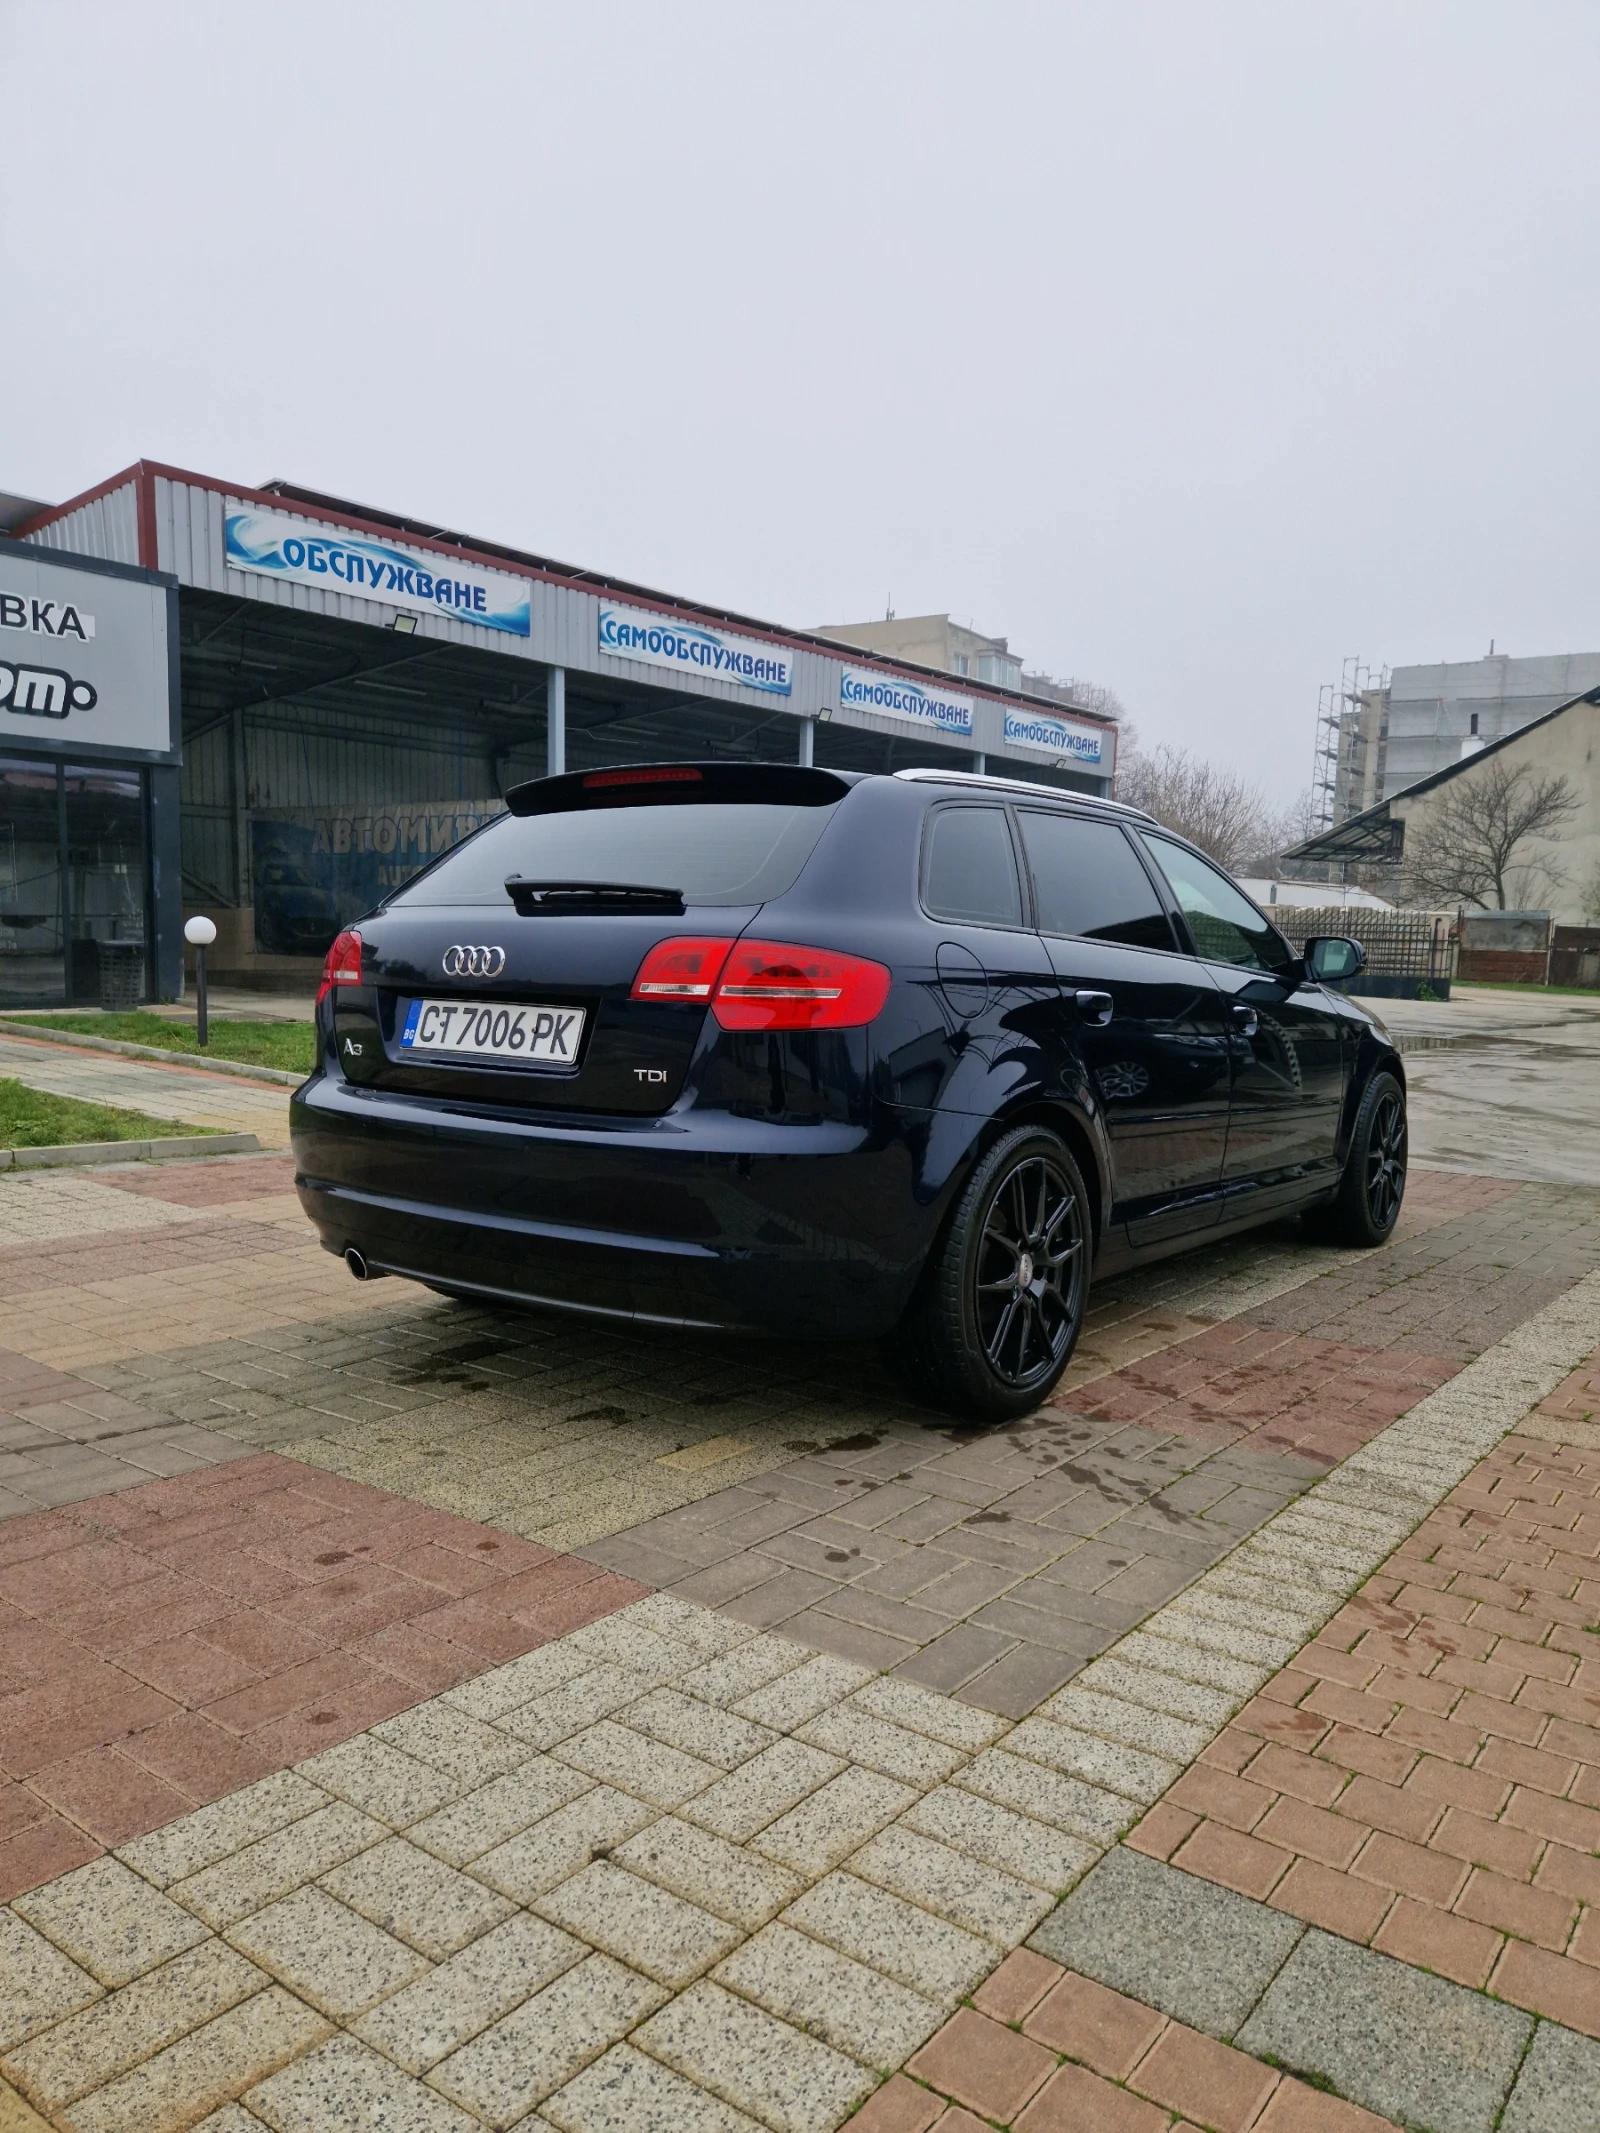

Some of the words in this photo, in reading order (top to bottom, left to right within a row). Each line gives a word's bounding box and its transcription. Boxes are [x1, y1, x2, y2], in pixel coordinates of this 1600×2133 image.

[283, 538, 487, 612] ОБСЛУЖВАНЕ
[606, 620, 787, 683] САМООБСЛУЖВАНЕ
[846, 680, 969, 726] САМООБСЛУЖВАНЕ
[1009, 720, 1099, 755] САМООБСЛУЖВАНЕ
[311, 814, 500, 854] АВТОМИВ
[343, 1037, 363, 1056] A3
[403, 1028, 415, 1040] BG
[633, 1068, 667, 1083] TDI
